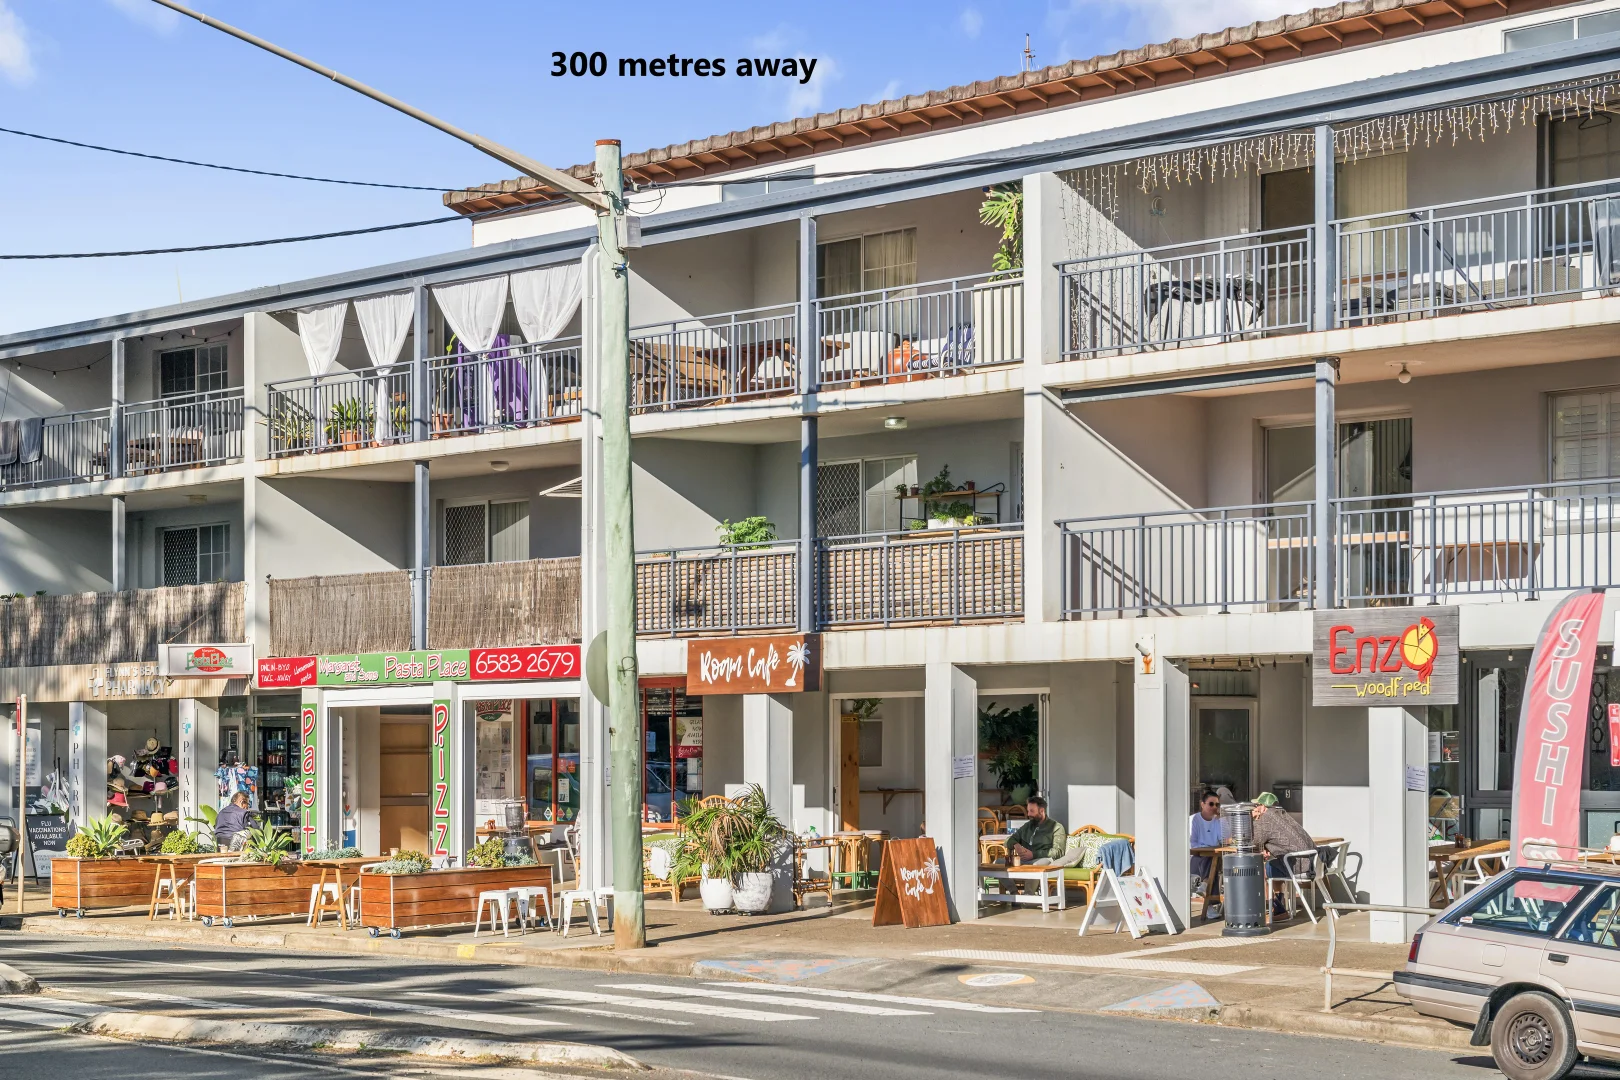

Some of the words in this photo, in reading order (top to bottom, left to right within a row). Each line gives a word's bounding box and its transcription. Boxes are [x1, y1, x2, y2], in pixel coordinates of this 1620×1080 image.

[106, 667, 138, 678] FLYNN'S
[319, 656, 360, 676] Margaret
[385, 655, 423, 679] Pasta
[427, 653, 467, 677] Place
[475, 651, 522, 674] 6583
[526, 649, 574, 676] 2679
[344, 672, 356, 682] and
[358, 669, 378, 681] Sons
[106, 679, 165, 697] PHARMACY
[1532, 619, 1585, 827] SUSHI
